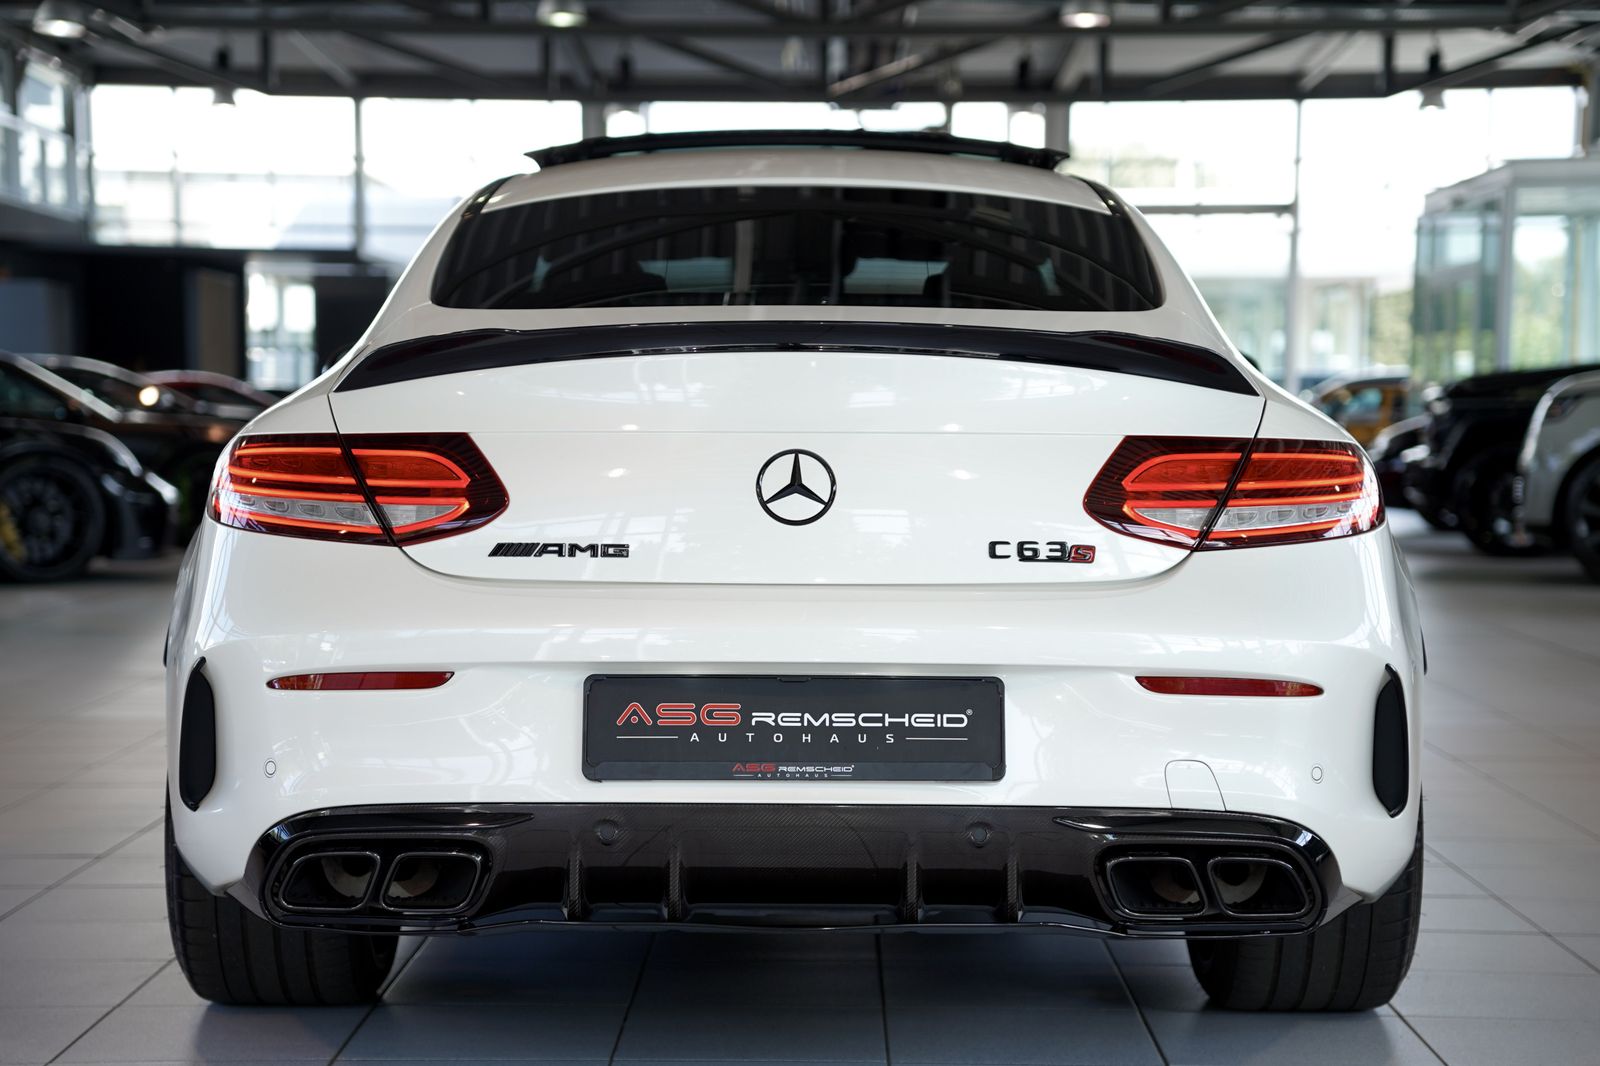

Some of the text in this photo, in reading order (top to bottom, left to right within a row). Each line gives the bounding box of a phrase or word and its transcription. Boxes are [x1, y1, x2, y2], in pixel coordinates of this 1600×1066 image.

[533, 543, 630, 558] AMG
[616, 702, 742, 727] ASG
[690, 732, 894, 744] AUTOHAUS
[732, 763, 776, 773] ASG
